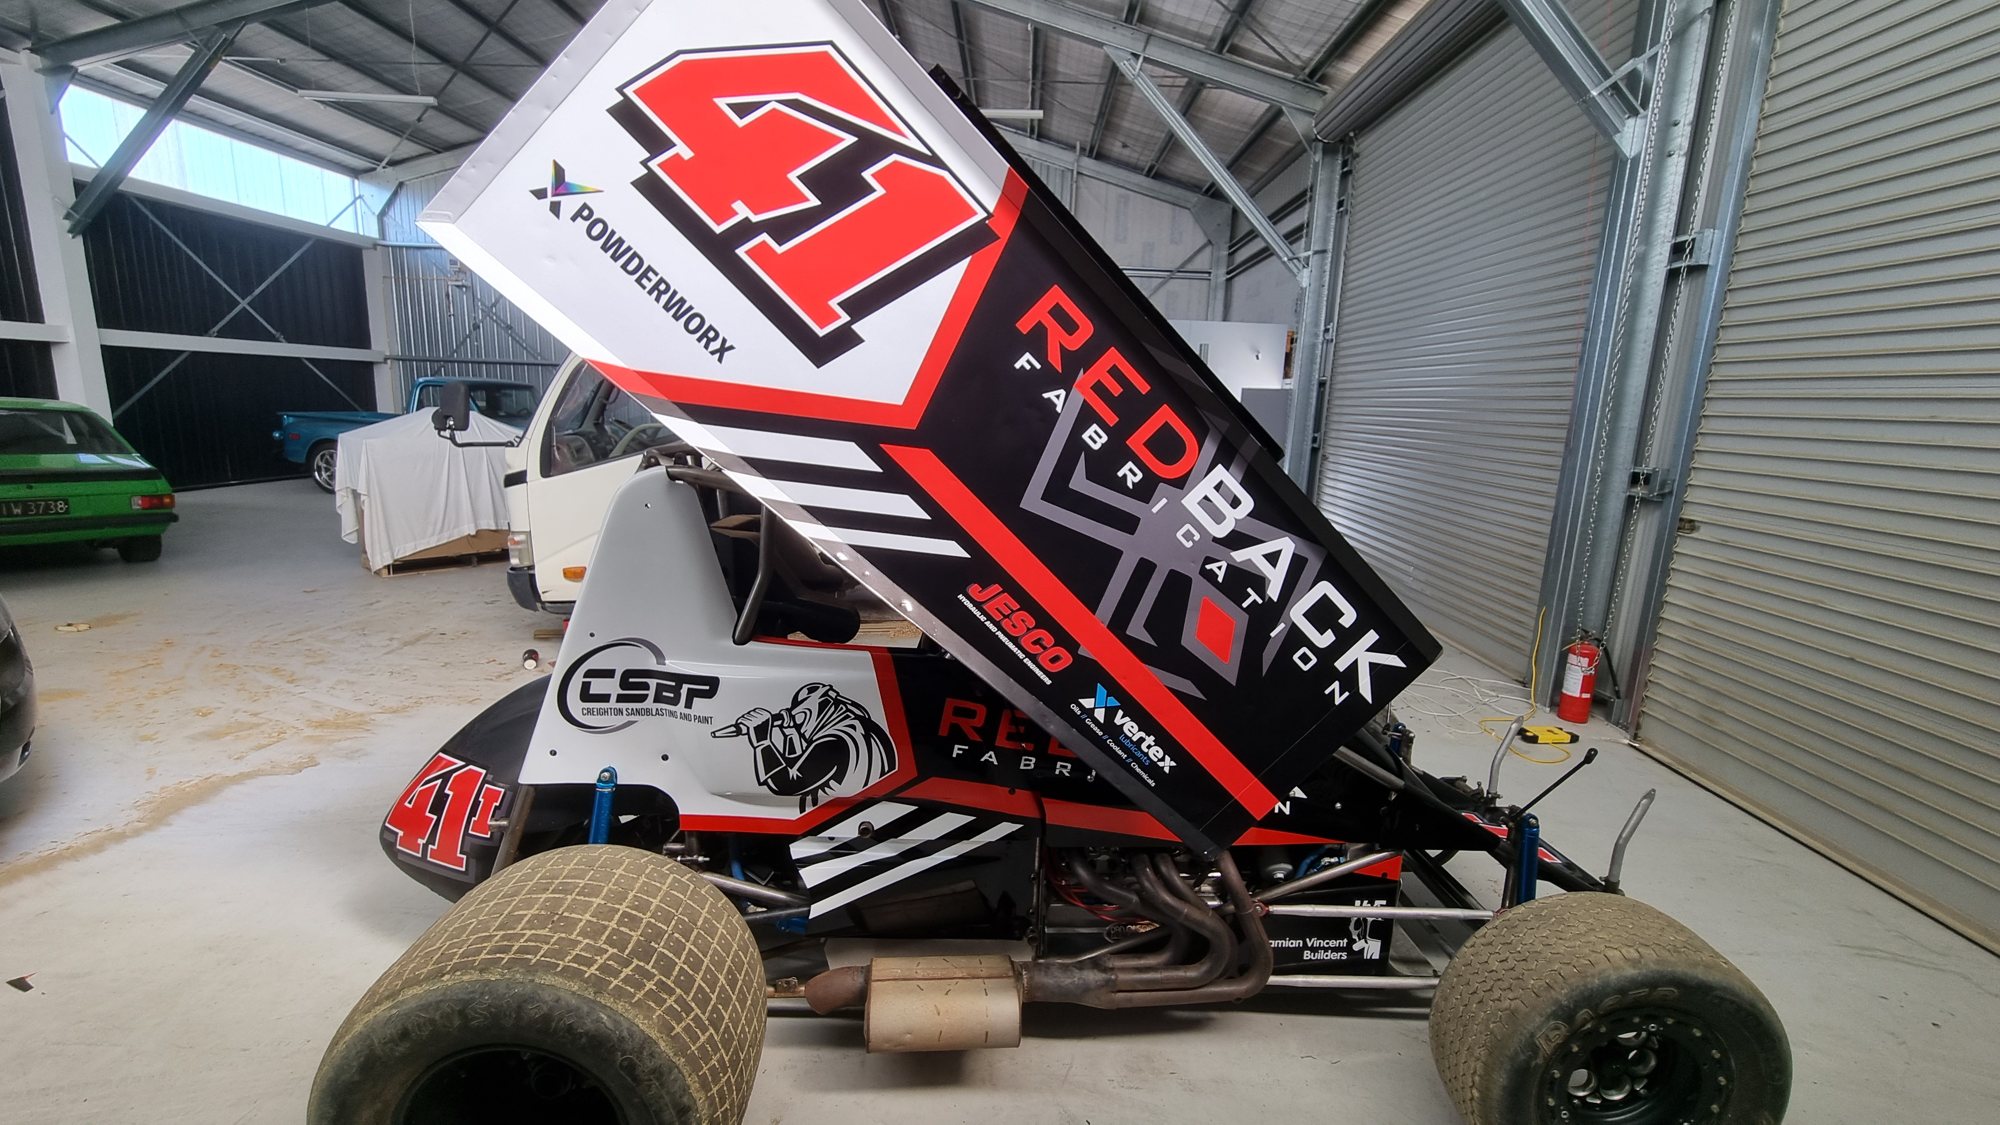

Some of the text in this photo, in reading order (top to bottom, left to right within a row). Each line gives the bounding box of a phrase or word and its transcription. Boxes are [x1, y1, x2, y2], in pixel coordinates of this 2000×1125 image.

[612, 40, 1000, 366] 41
[570, 201, 737, 364] POWDERWORX
[28, 500, 66, 514] 3738
[1013, 352, 1350, 706] FABRICATION
[1015, 284, 1407, 704] REDBACK
[957, 594, 1052, 686] HYDRAULIC AND PNEUMATIC ENGINEERS
[966, 583, 1073, 673] JESCO
[579, 668, 721, 710] CSBP
[581, 707, 714, 726] CREIGHTON SANDBLASTING AND PAINT
[1070, 703, 1082, 716] Oils
[1085, 717, 1104, 737] Grease
[1106, 738, 1128, 760] Coolant
[1130, 761, 1156, 788] Chemicals
[1113, 708, 1177, 775] vertex
[1118, 733, 1151, 766] lubricants
[1268, 937, 1348, 948] amian Vincent
[1303, 950, 1348, 960] Builders
